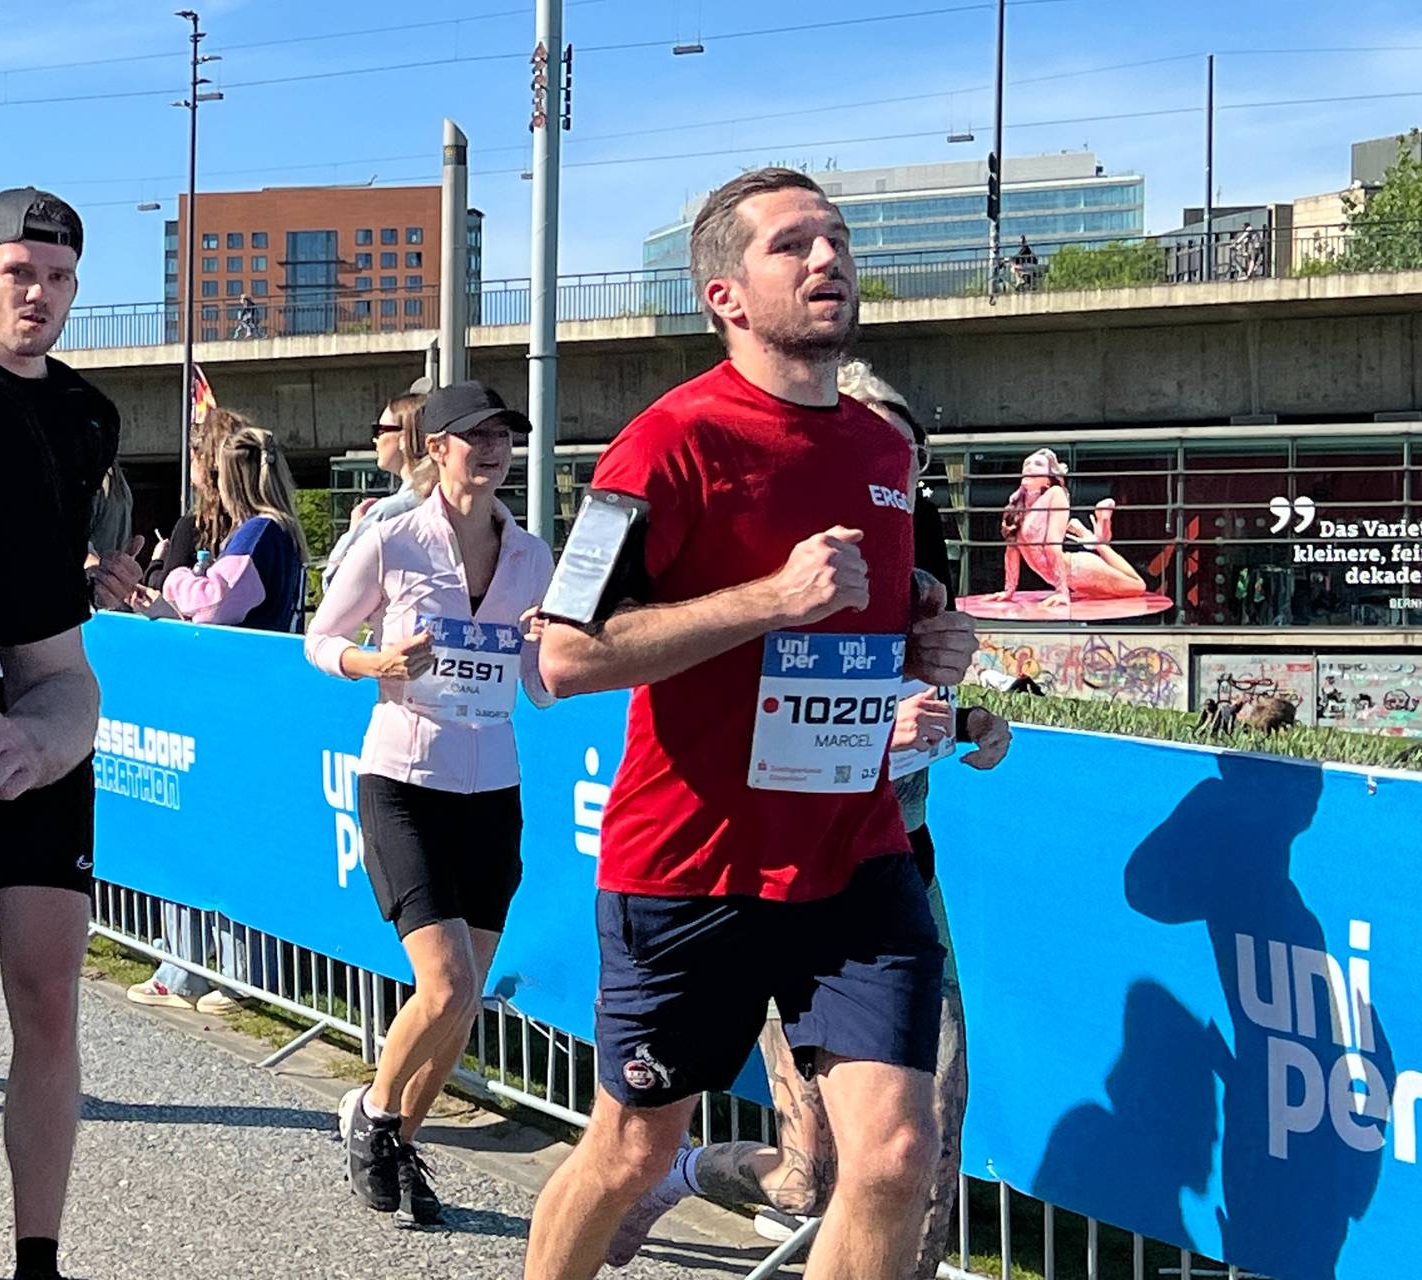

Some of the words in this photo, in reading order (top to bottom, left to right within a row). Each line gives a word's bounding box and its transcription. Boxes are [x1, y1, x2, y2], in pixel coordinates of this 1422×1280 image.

[1319, 520, 1359, 538] Das
[1293, 544, 1386, 565] kleinere,
[1391, 544, 1422, 562] fei
[778, 635, 809, 655] uni
[838, 636, 866, 657] uni
[431, 658, 504, 683] 12591
[781, 653, 819, 672] per
[842, 655, 876, 673] per
[94, 717, 195, 772] SSELDORF
[814, 734, 874, 748] MARCEL
[92, 752, 180, 811] ARATHON
[322, 749, 359, 812] un
[1236, 919, 1376, 1053] uni
[1267, 1036, 1422, 1164] per
